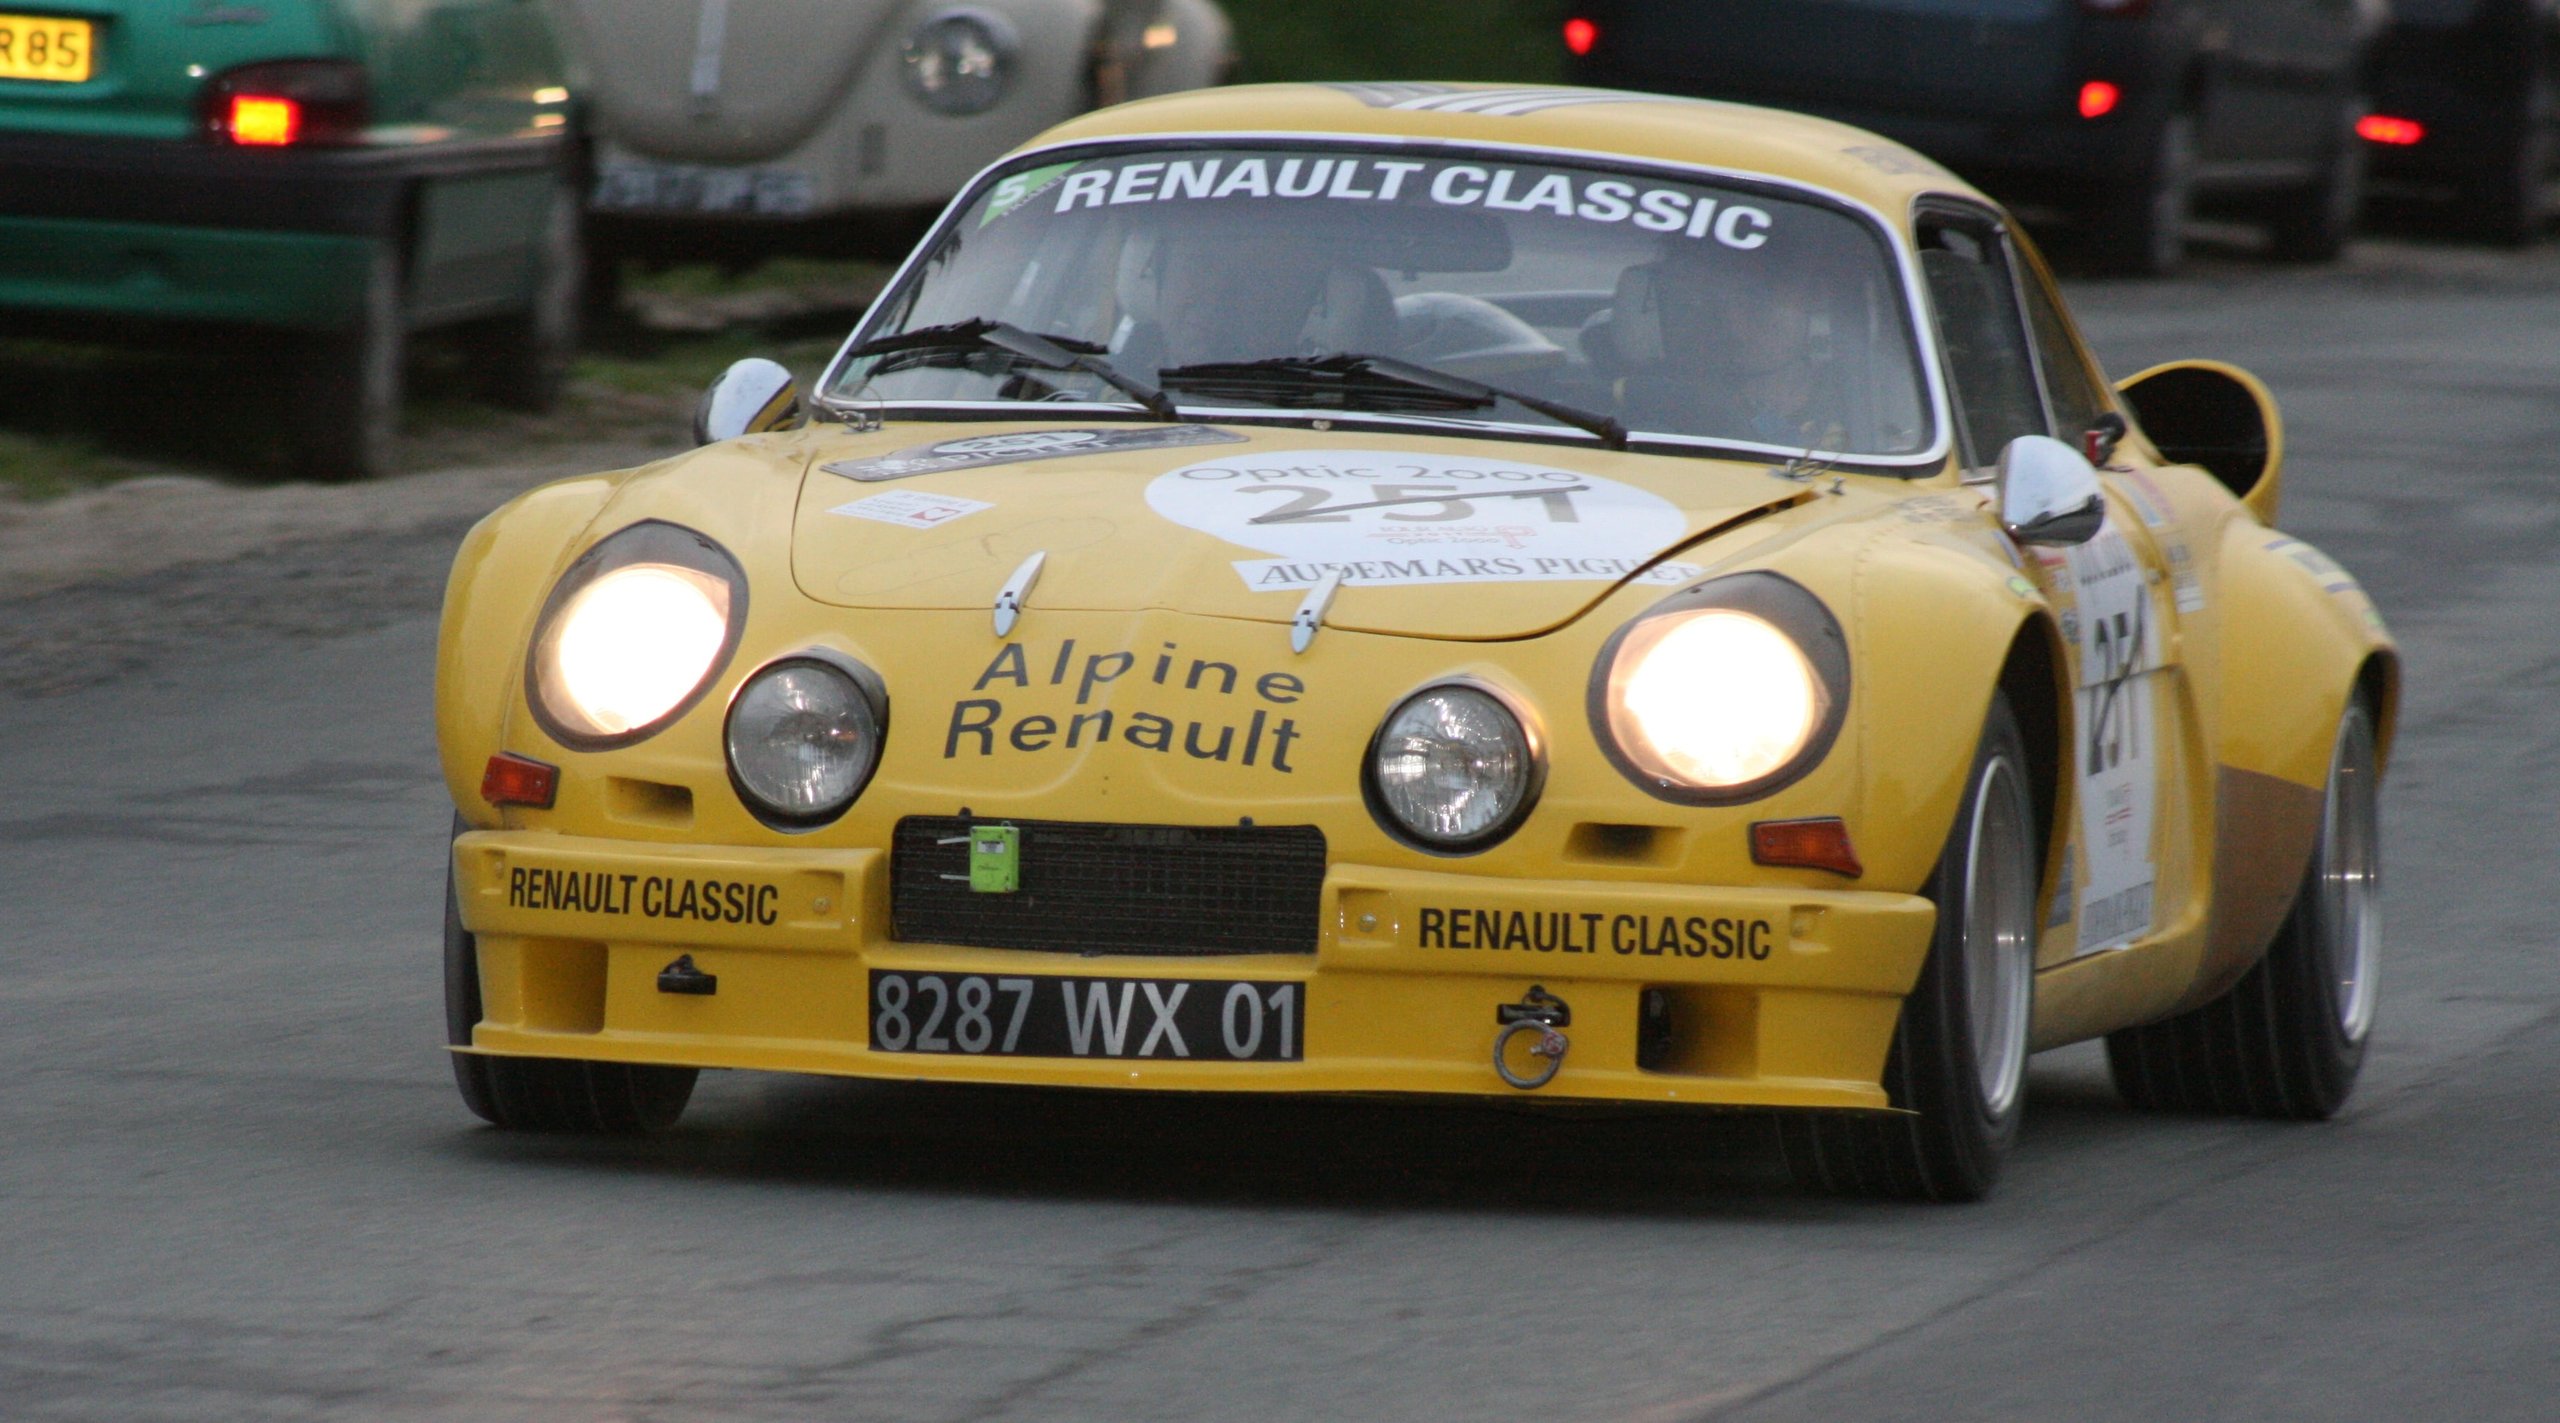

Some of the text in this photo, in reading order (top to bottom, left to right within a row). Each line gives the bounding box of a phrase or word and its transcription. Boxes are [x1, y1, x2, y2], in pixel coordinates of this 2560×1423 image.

[27, 30, 78, 67] 85
[1054, 158, 1423, 214] RENAULT
[1430, 165, 1773, 251] CLASSIC
[940, 438, 1112, 464] PICTET
[1178, 463, 1582, 483] Optic 2000
[1235, 484, 1591, 525] 251
[972, 638, 1304, 705] Alpine
[944, 697, 1301, 774] Renault
[509, 866, 779, 926] RENAULT CLASSIC
[1418, 907, 1771, 961] RENAULT CLASSIC
[875, 974, 1294, 1060] 8287 WX 01
